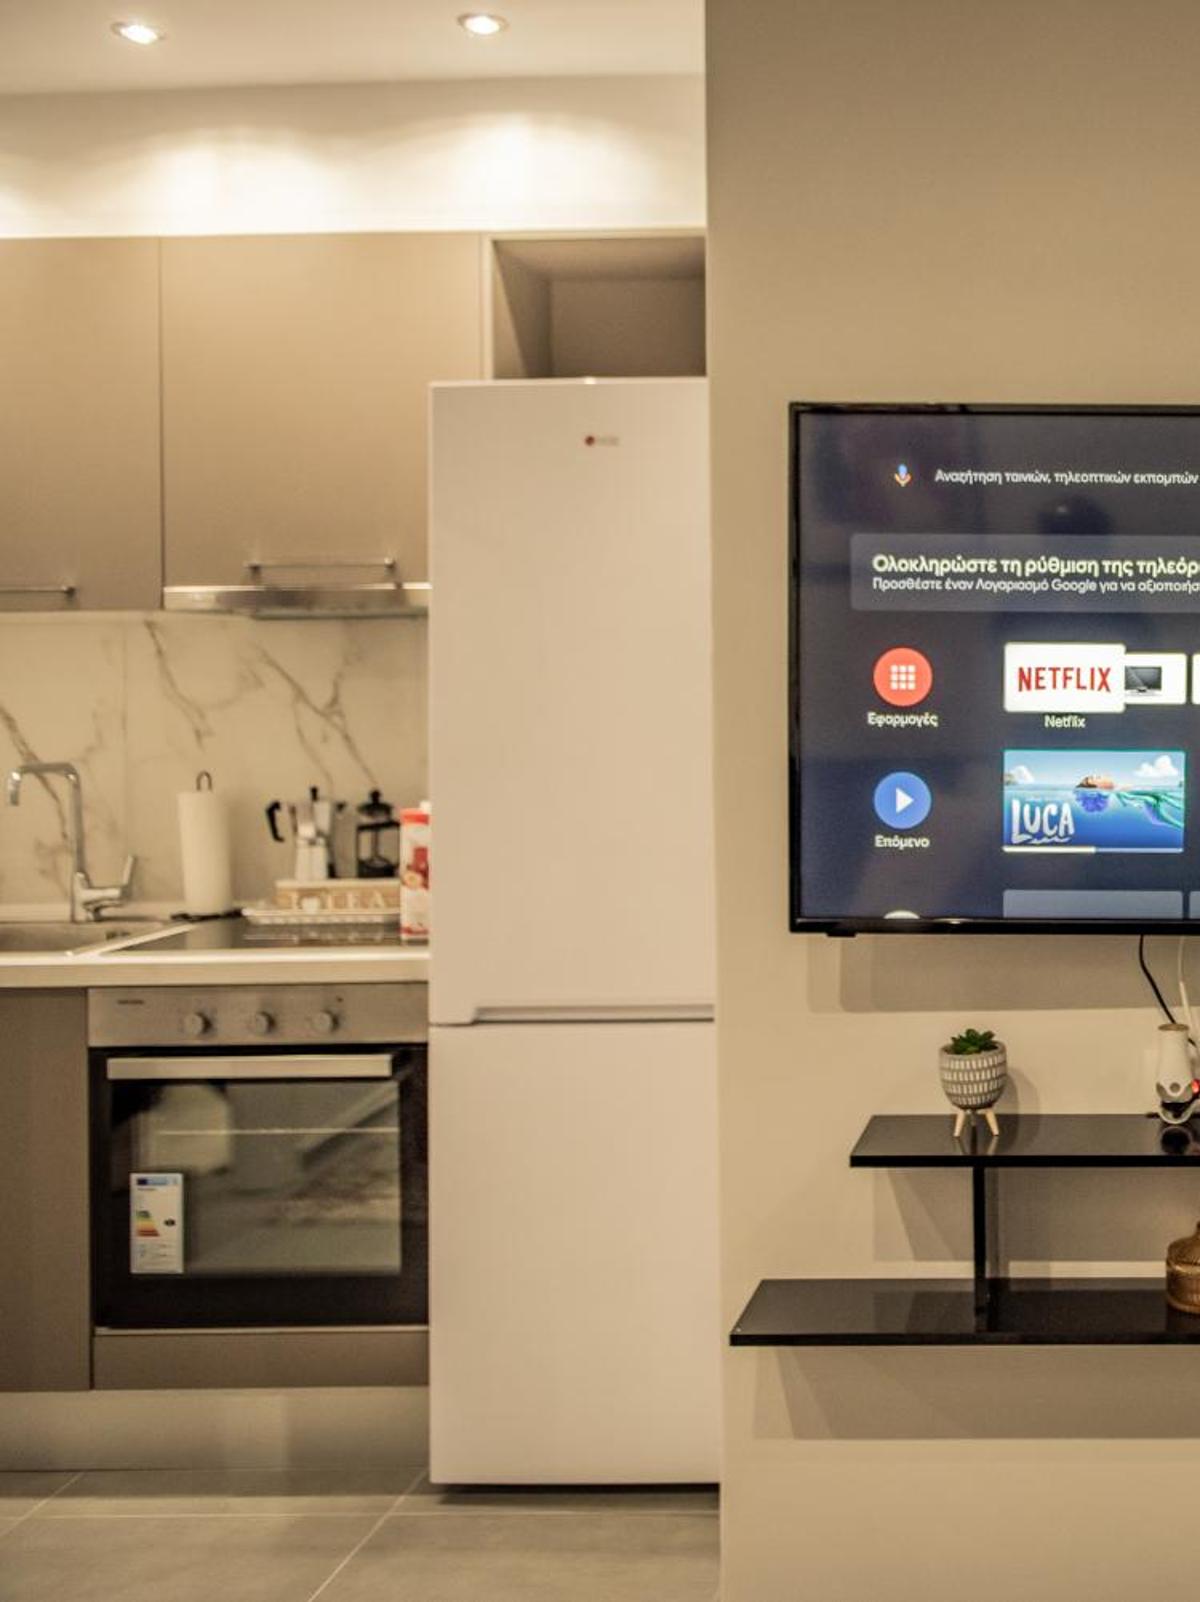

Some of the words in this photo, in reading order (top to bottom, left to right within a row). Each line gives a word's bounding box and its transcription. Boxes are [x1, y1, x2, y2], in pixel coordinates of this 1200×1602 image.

[934, 468, 1002, 486] Αναζήτηση
[1005, 469, 1051, 485] ταινιών,
[1054, 469, 1131, 486] τηλεοπτικών
[1133, 470, 1199, 487] εκπομπών
[872, 554, 997, 577] Ολοκληρώστε
[1001, 558, 1022, 578] τη
[1024, 555, 1099, 578] ρύθμιση
[1101, 559, 1134, 578] της
[872, 577, 943, 593] Προσθέστε
[945, 577, 974, 591] έναν
[975, 577, 1049, 594] Λογαριασμό
[1051, 578, 1097, 595] Google
[1099, 581, 1118, 594] για
[1119, 581, 1136, 592] να
[1017, 666, 1111, 692] NETFLIX
[867, 711, 939, 728] Εφαρμογές
[1044, 714, 1086, 729] Netflix
[1011, 799, 1075, 845] LUCA
[875, 834, 930, 849] Επόμενο
